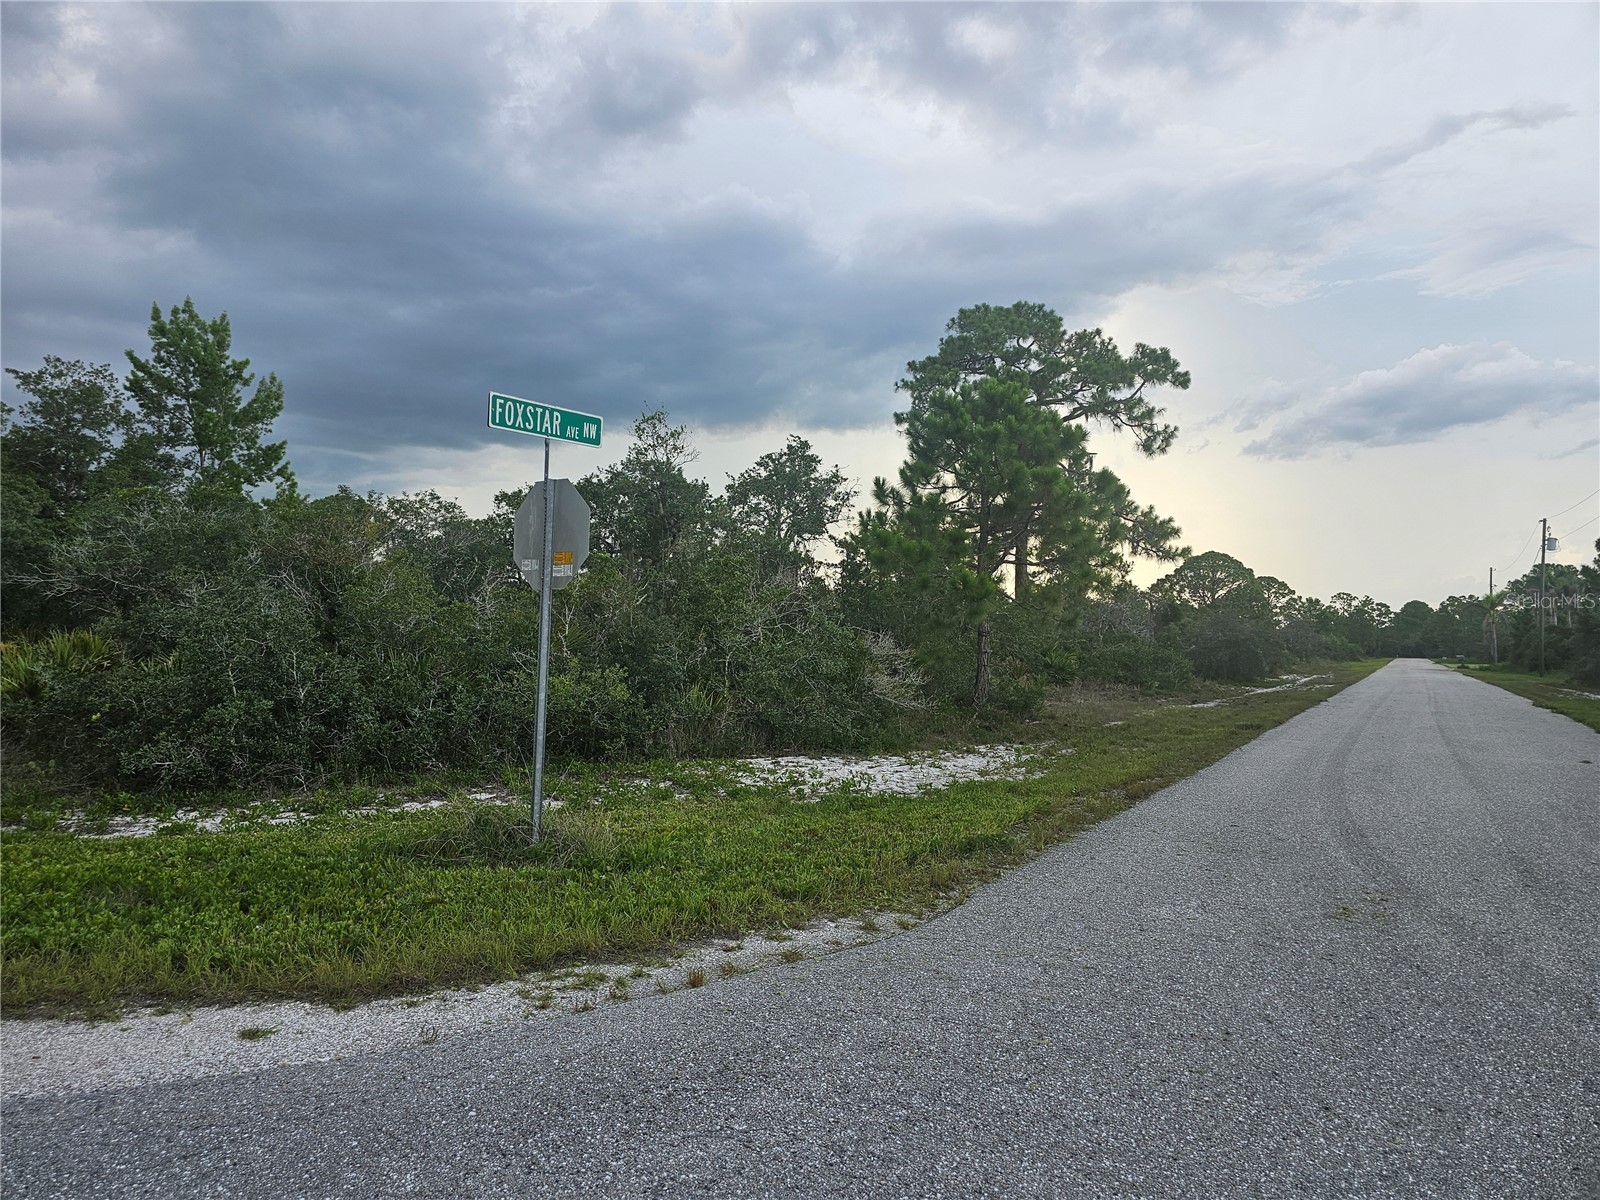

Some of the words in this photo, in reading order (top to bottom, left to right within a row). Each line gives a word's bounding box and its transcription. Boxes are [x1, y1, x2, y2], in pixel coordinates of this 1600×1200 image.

[495, 398, 561, 435] FOXSTAR
[566, 425, 579, 439] AVE
[583, 422, 597, 439] NW
